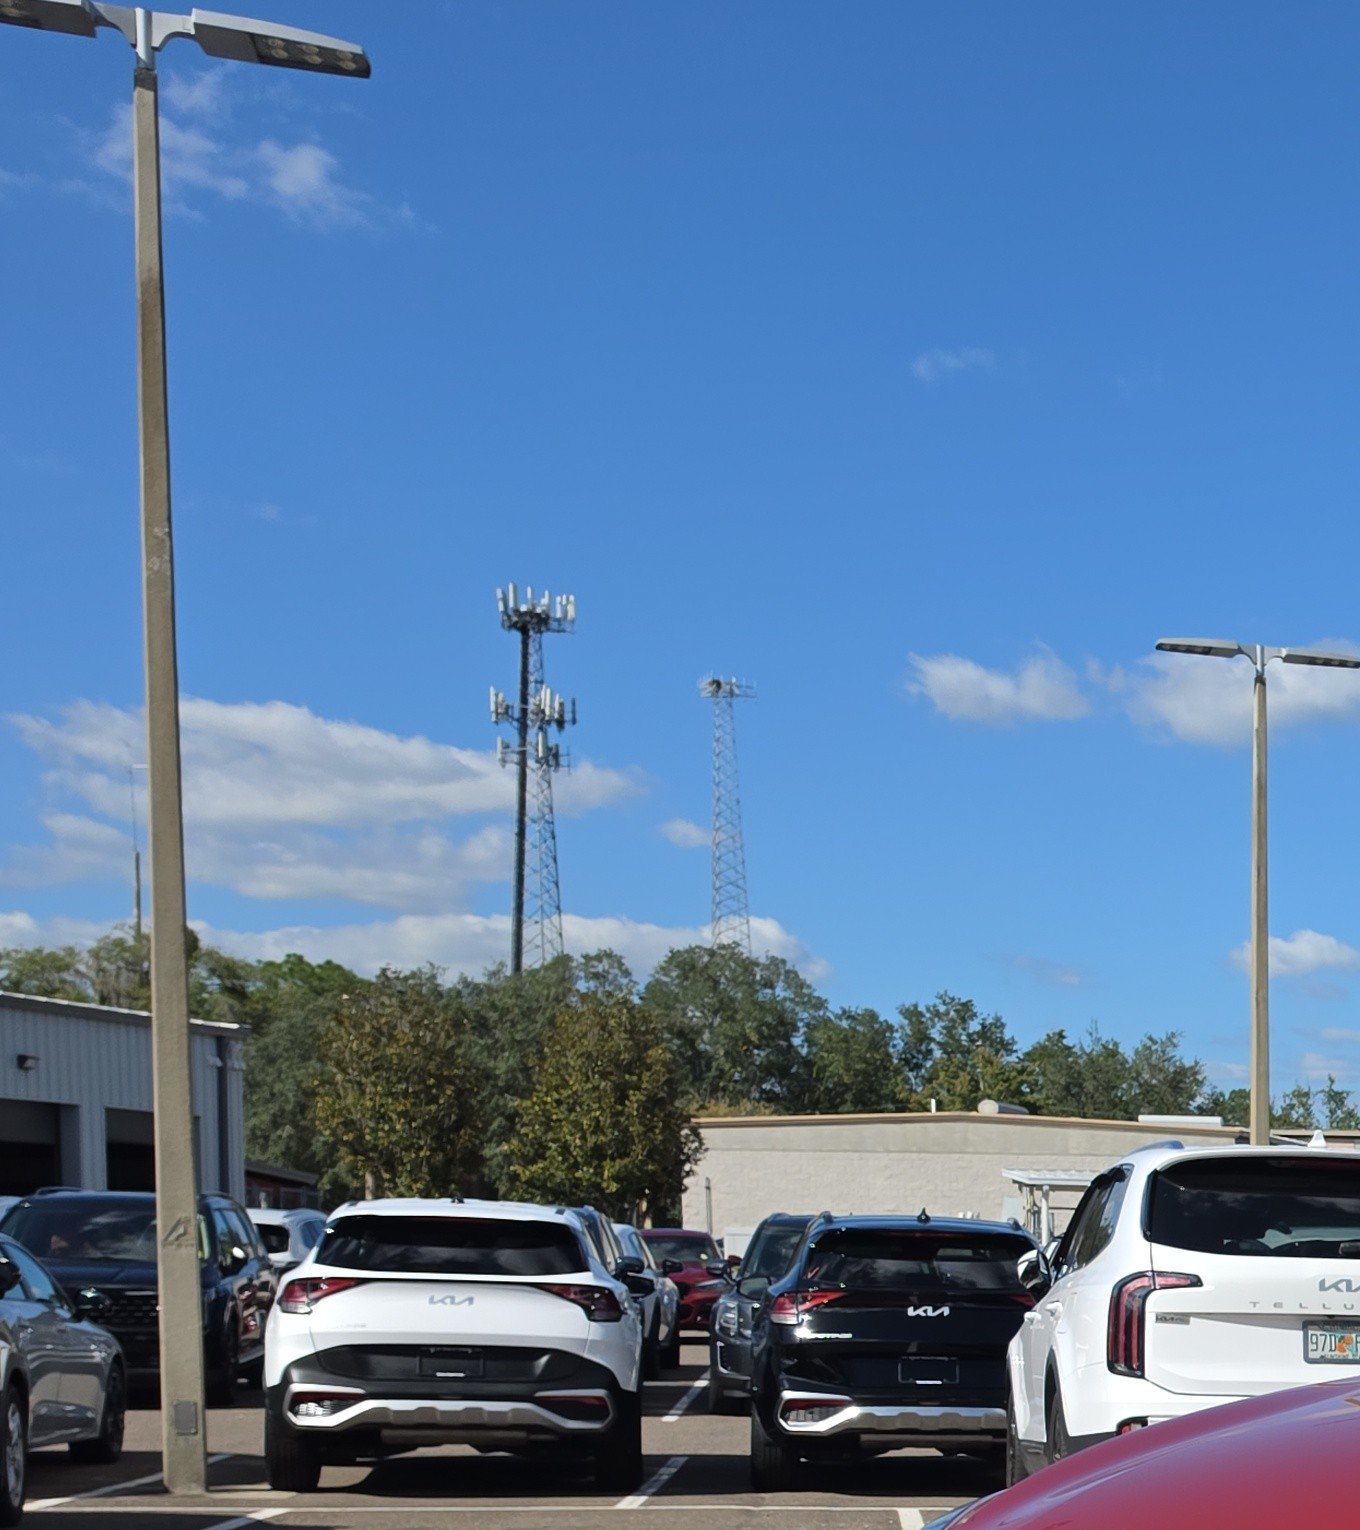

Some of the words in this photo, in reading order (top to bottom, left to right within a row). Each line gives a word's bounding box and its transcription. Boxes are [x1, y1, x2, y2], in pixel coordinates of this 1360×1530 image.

[428, 1295, 474, 1306] KIA
[907, 1306, 950, 1317] KIA
[1310, 1333, 1337, 1352] 97D
